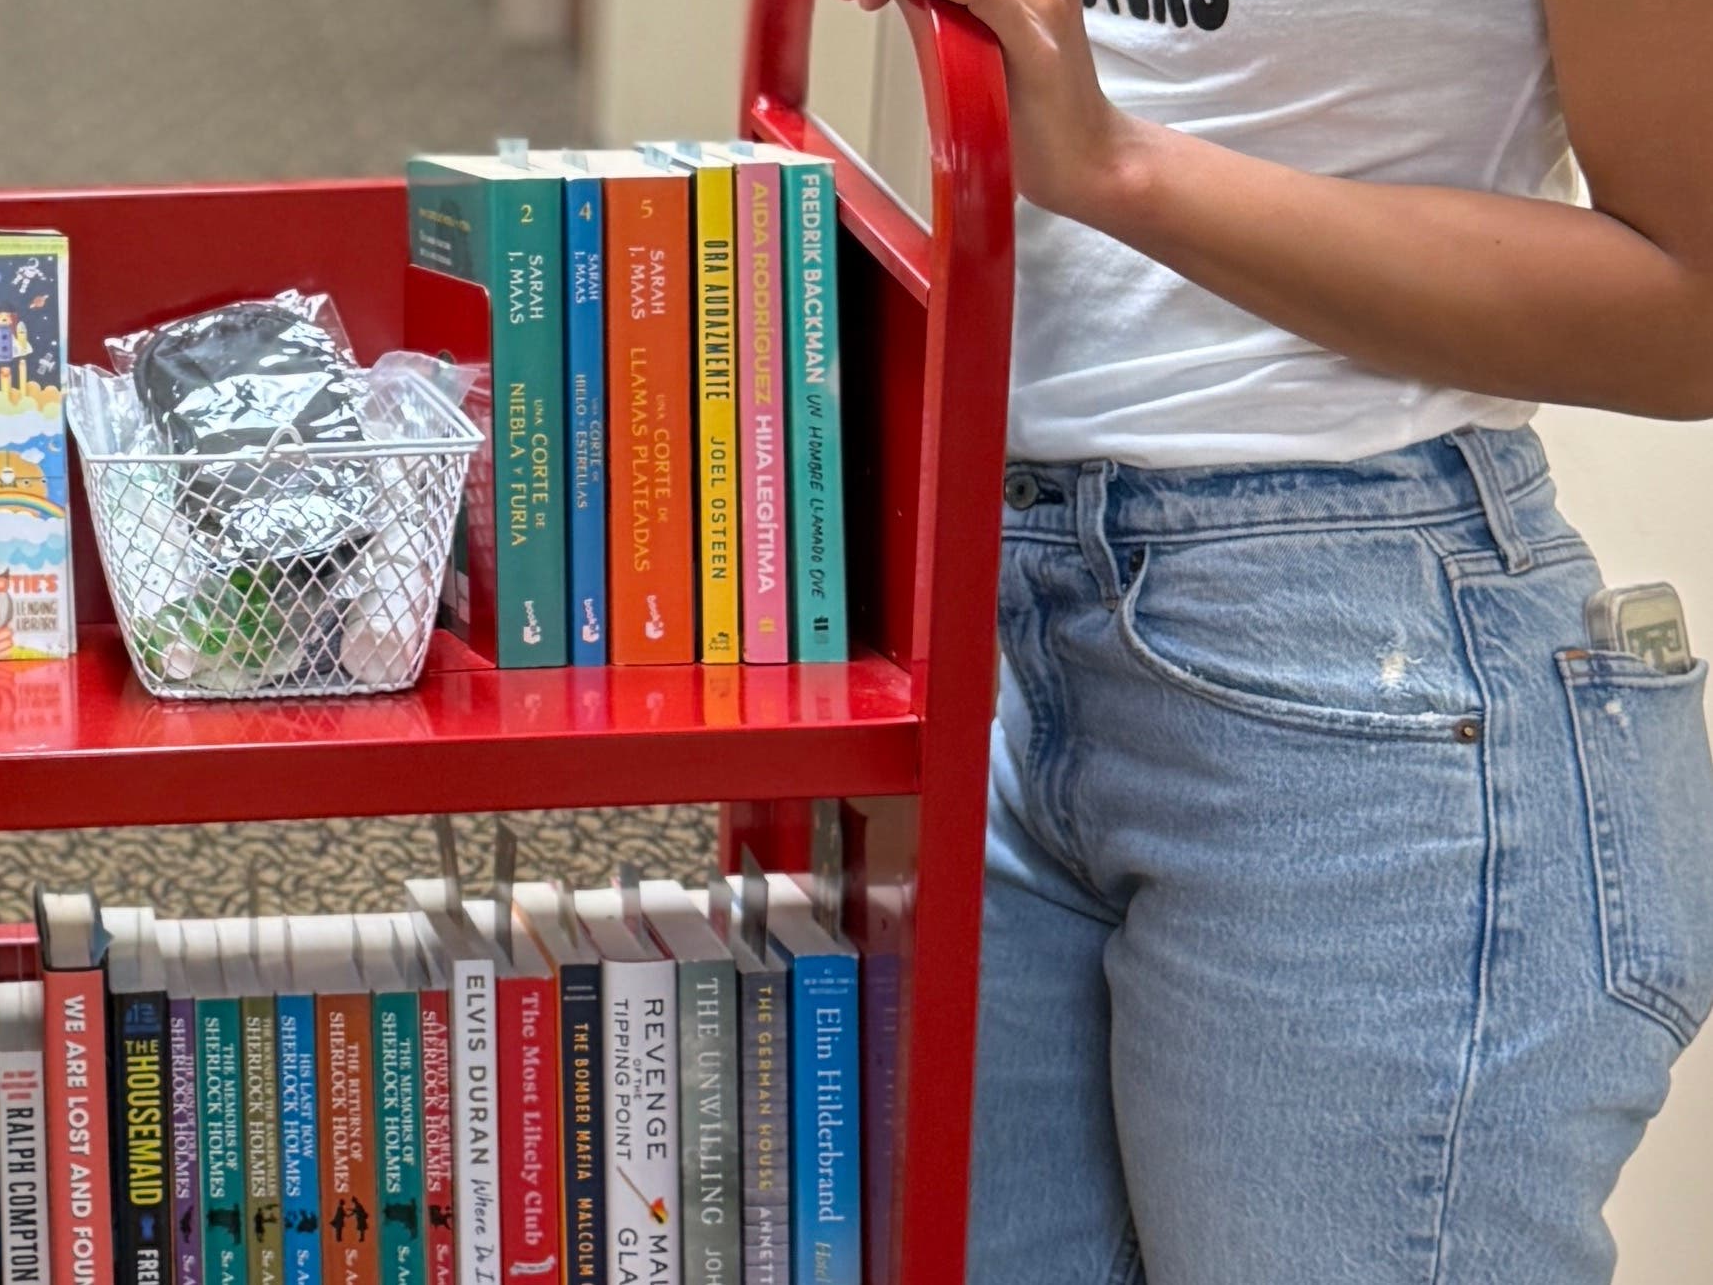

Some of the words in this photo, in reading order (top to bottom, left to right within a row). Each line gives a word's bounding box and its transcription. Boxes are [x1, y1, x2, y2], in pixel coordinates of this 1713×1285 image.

[520, 204, 534, 223] 2
[579, 201, 593, 221] 4
[640, 199, 653, 219] 5
[752, 182, 768, 247] AIDA
[801, 174, 822, 264] FREDRIK
[529, 255, 545, 319] SARAH
[575, 264, 586, 304] MAAS
[588, 254, 600, 300] SARAH
[649, 249, 665, 315] SARAH
[704, 240, 729, 273] ORA
[509, 269, 524, 324] MAAS
[630, 265, 646, 320] MAAS
[704, 284, 730, 400] AUDAZMENTE
[753, 253, 774, 405] RODRÍGUEZ
[803, 269, 825, 384] BACKMAN
[509, 383, 526, 459] NIEBLA
[575, 374, 586, 415] HIELO
[630, 348, 647, 437] LLAMAS
[805, 394, 823, 419] UN
[531, 434, 548, 503] CORTE
[576, 431, 588, 508] ESTRELLAS
[653, 429, 671, 499] CORTE
[710, 437, 726, 488] JOEL
[755, 415, 773, 470] HIJA
[807, 426, 825, 492] HOMBRE
[510, 483, 527, 546] FURIA
[535, 512, 546, 529] DE
[632, 446, 650, 572] PLATEADAS
[711, 498, 726, 579] OSTEEN
[756, 475, 778, 594] LEGÍTIMA
[809, 499, 825, 563] LLAMADO
[809, 569, 826, 600] OVE
[64, 995, 85, 1033] WE
[466, 975, 486, 1051] ELVIS
[521, 992, 539, 1038] The
[696, 977, 720, 1038] THE
[757, 987, 773, 1023] THE
[816, 1007, 842, 1060] Elin
[65, 1040, 87, 1088] ARE
[125, 1040, 159, 1054] THE
[205, 1017, 223, 1116] SHERLOCK
[222, 1043, 235, 1074] THE
[281, 1015, 298, 1112] SHERLOCK
[299, 1053, 312, 1077] HIS
[329, 1012, 348, 1109] SHERLOCK
[347, 1042, 360, 1072] THE
[574, 1023, 589, 1052] THE
[613, 999, 630, 1086] TIPPING
[633, 1059, 641, 1075] OF
[300, 1082, 314, 1116] LAST
[523, 1048, 542, 1103] Most
[574, 1059, 590, 1123] BOMBER
[634, 1077, 643, 1100] THE
[644, 999, 667, 1161] REVENGE
[757, 1032, 773, 1115] GERMAN
[68, 1097, 90, 1156] LOST
[127, 1055, 163, 1207] HOUSEMAID
[223, 1080, 237, 1147] MEMOIRS
[348, 1078, 361, 1138] RETURN
[468, 1066, 489, 1165] DURAN
[615, 1094, 631, 1161] POINT
[697, 1050, 723, 1225] UNWILLING
[6, 1106, 35, 1174] RALPH
[208, 1123, 226, 1199] HOLMES
[226, 1151, 238, 1170] OF
[283, 1120, 301, 1197] HOLMES
[300, 1125, 314, 1159] BOW
[333, 1117, 350, 1194] HOLMES
[350, 1142, 363, 1162] OF
[520, 1111, 542, 1187] Likely
[575, 1131, 591, 1180] MAFIA
[757, 1123, 773, 1192] HOUSE
[817, 1070, 845, 1222] Hilderbrand
[70, 1163, 92, 1218] AND
[470, 1178, 492, 1236] Where
[523, 1191, 545, 1245] Club
[8, 1182, 39, 1283] COMPTON
[577, 1197, 594, 1277] MALCOLM
